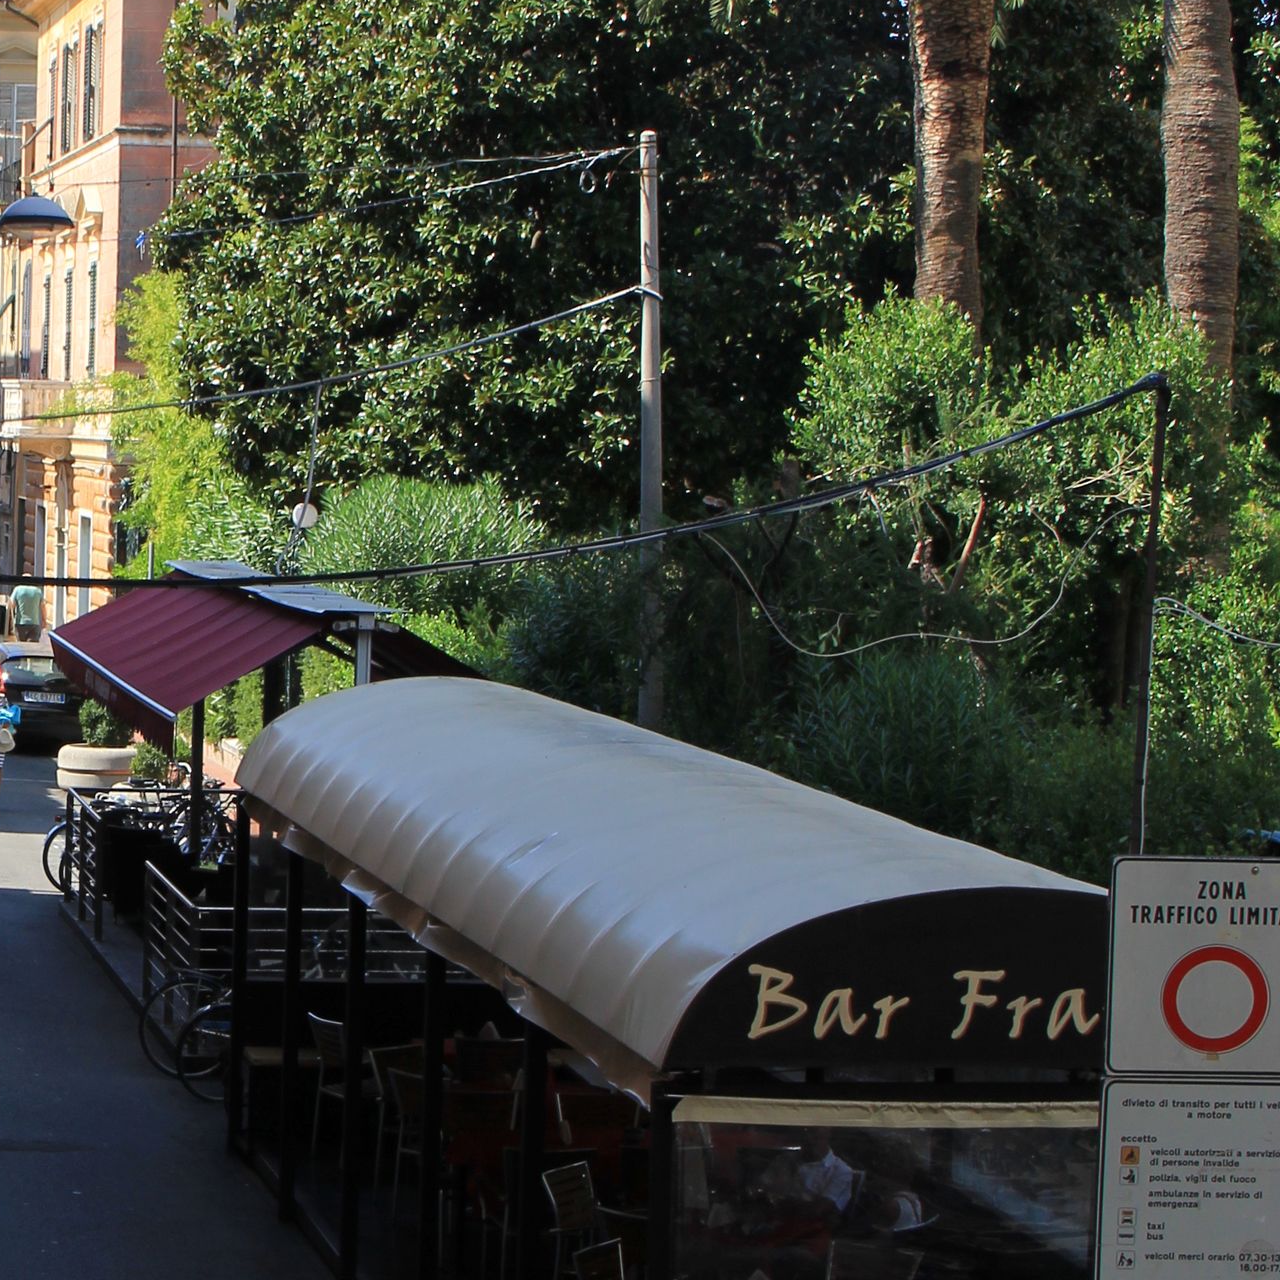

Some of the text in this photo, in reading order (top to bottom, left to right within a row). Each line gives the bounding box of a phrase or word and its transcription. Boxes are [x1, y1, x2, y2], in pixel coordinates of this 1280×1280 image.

[1197, 881, 1246, 900] ZONA
[1130, 905, 1280, 925] TRAFFICO LIMIT
[748, 963, 1101, 1041] Bar Fra
[1122, 1098, 1155, 1108] divieto
[1159, 1099, 1168, 1108] di
[1172, 1099, 1210, 1109] transito
[1214, 1100, 1230, 1111] per
[1234, 1100, 1256, 1109] tutti
[1197, 1111, 1232, 1120] motore
[1120, 1135, 1157, 1143] eccetto
[1150, 1148, 1180, 1156] veicoli
[1184, 1148, 1233, 1158] autorizzati
[1236, 1150, 1242, 1158] a
[1150, 1158, 1240, 1168] di persone invalide
[1185, 1174, 1208, 1185] vigili
[1229, 1174, 1256, 1184] fuoco
[1148, 1189, 1263, 1199] ambulanze in servizio di
[1147, 1200, 1198, 1209] emergenza
[1147, 1222, 1165, 1230] taxi
[1146, 1232, 1164, 1240] bus
[1144, 1251, 1174, 1260] veicoli
[1178, 1252, 1204, 1261] merci
[1208, 1252, 1235, 1261] orario
